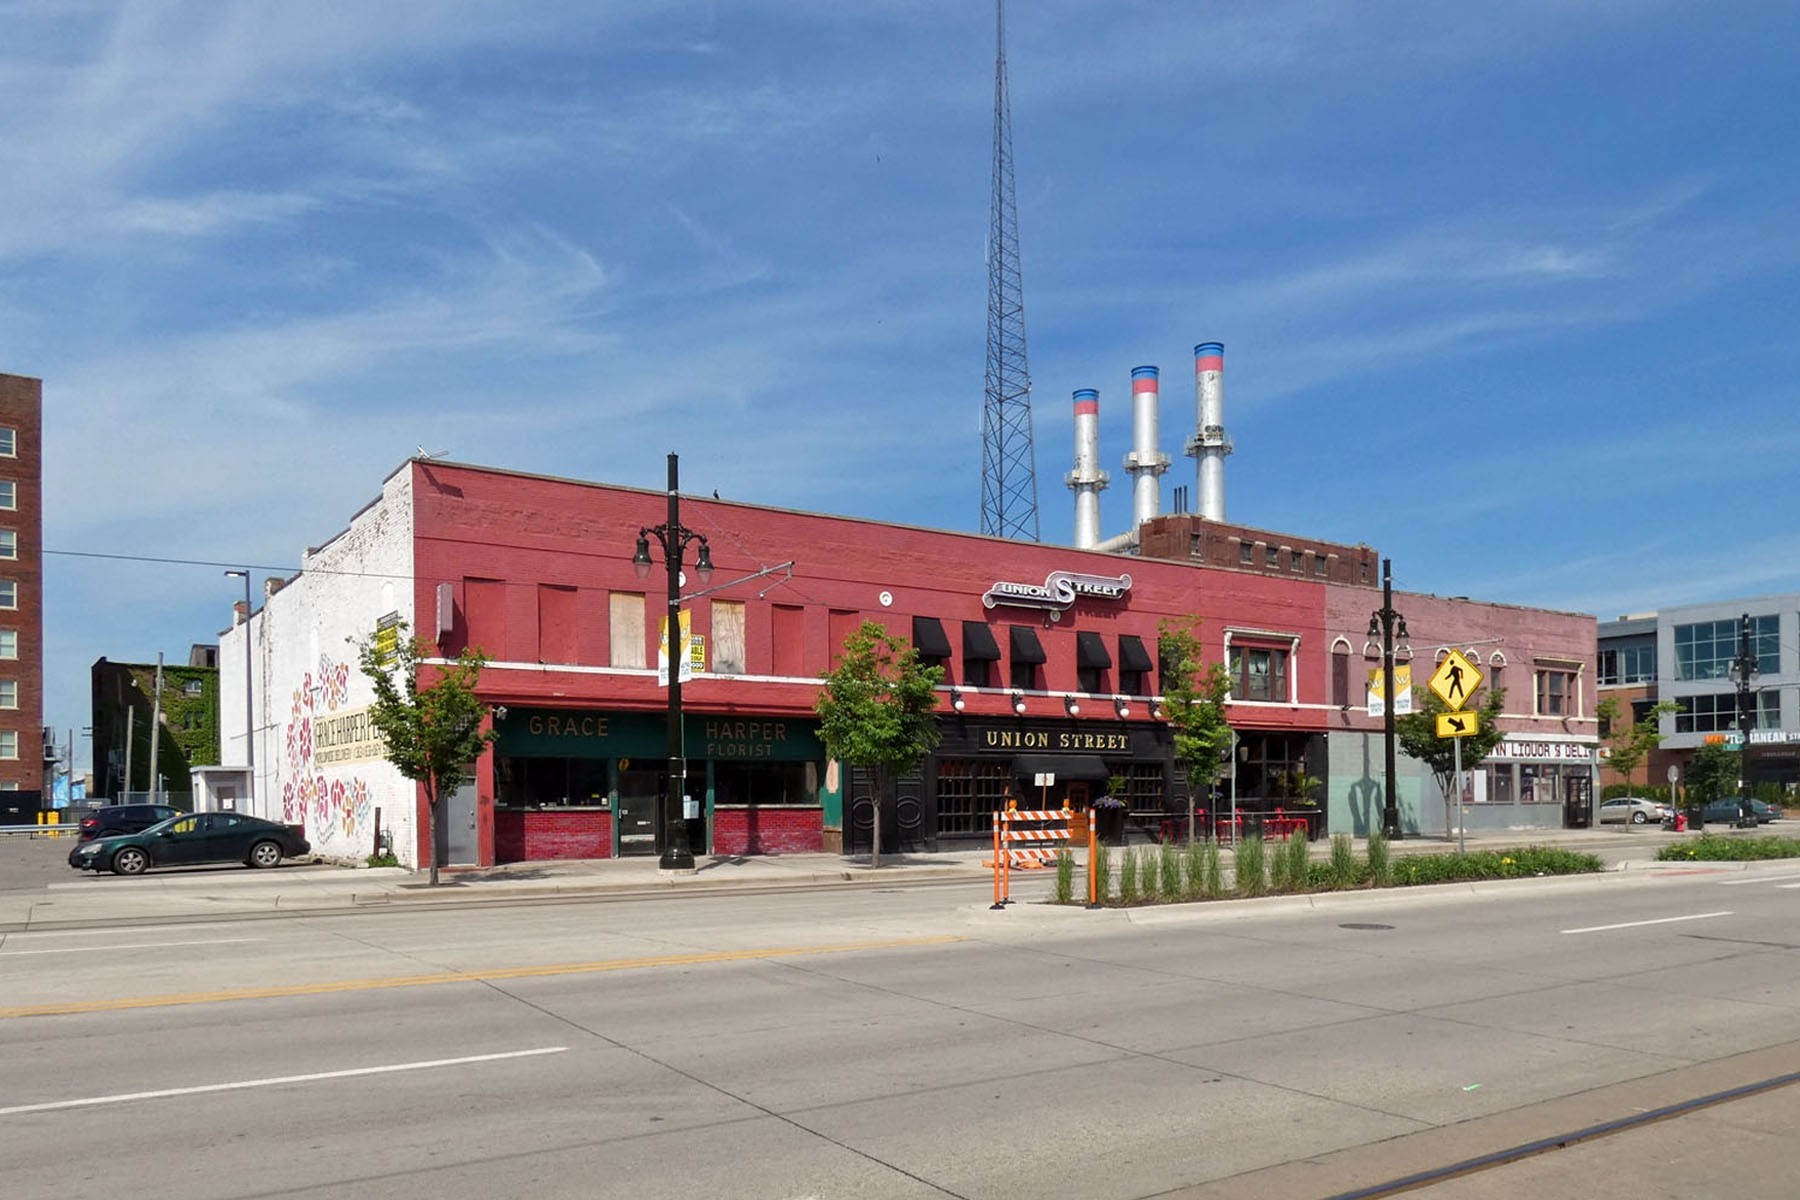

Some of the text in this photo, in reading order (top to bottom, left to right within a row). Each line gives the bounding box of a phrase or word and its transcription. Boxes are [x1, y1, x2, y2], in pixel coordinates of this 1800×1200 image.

[1001, 578, 1120, 603] UNION STREET
[529, 715, 609, 737] GRACE
[706, 721, 787, 741] HARPER
[986, 731, 1129, 749] UNION STREET
[707, 743, 773, 757] FLORIST
[1511, 742, 1551, 757] LIQUOR
[1565, 744, 1590, 758] DELI
